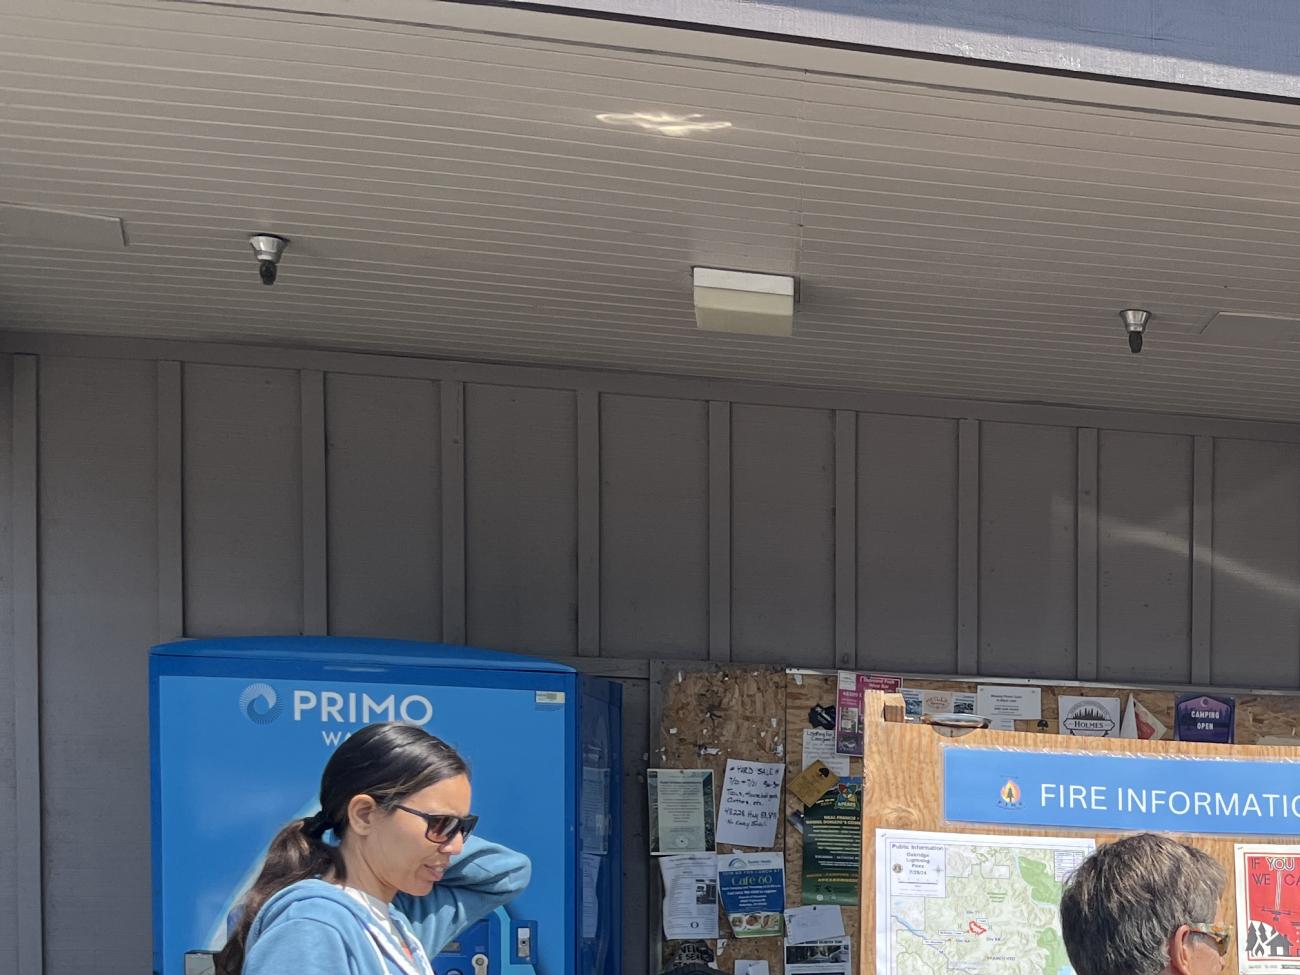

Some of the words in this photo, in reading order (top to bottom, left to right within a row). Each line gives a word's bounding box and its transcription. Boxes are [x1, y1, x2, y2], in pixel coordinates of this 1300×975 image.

[294, 690, 433, 726] PRIMO
[1191, 711, 1220, 720] CAMPING
[1074, 720, 1104, 728] HOLMES
[1041, 783, 1107, 810] FIRE
[1251, 858, 1261, 870] IF
[1265, 856, 1296, 871] YOU
[1252, 873, 1270, 885] WE
